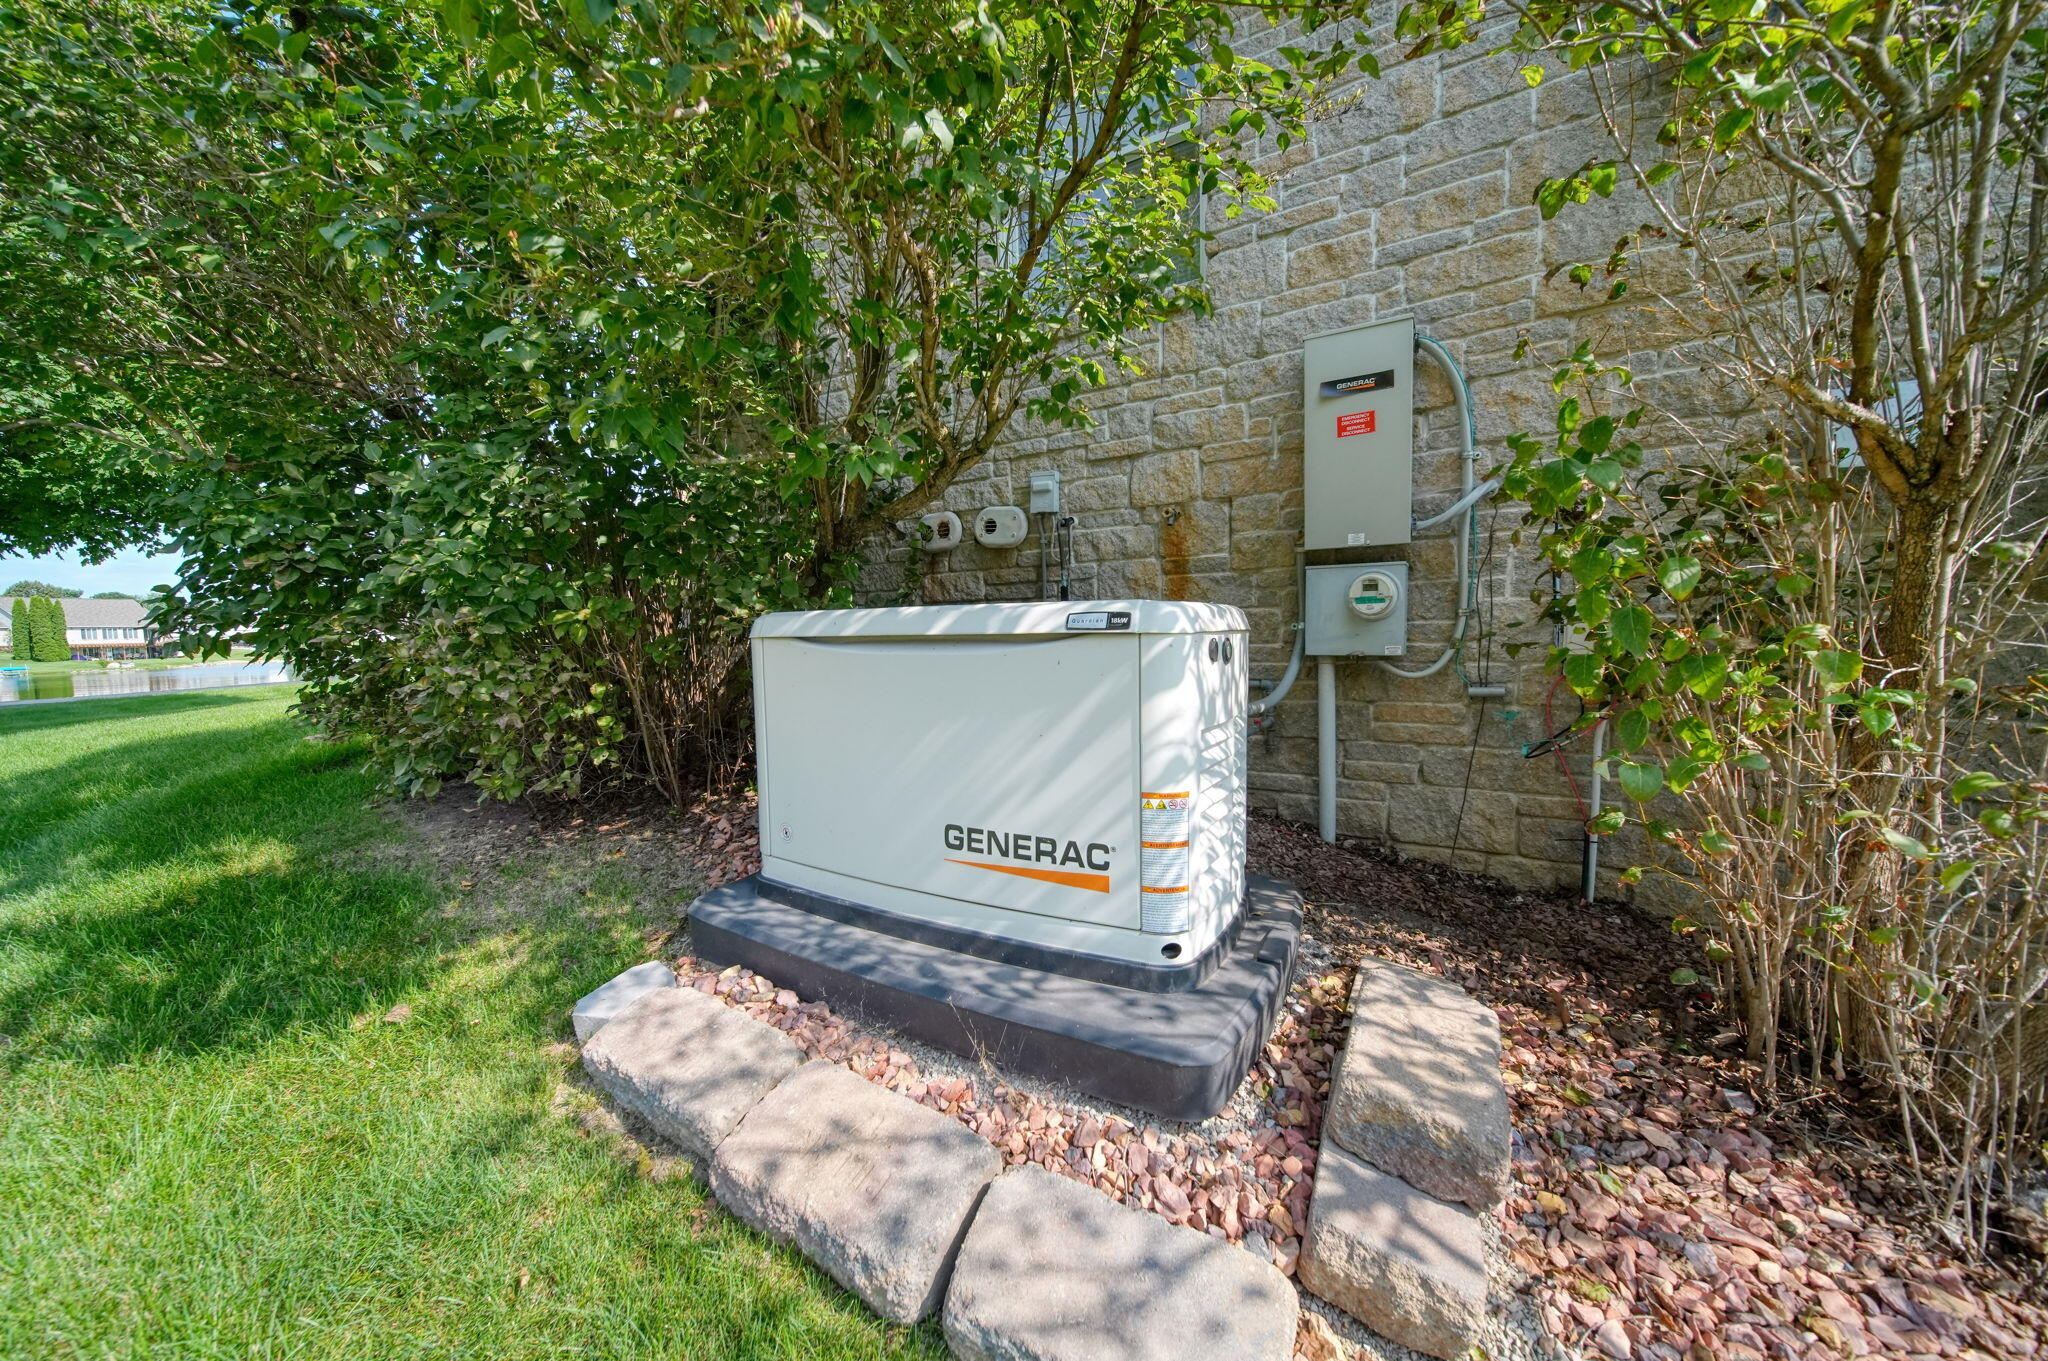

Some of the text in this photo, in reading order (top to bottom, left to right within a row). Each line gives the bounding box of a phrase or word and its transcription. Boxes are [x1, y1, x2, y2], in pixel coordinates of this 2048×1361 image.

[1336, 377, 1376, 390] GENERAC
[1341, 417, 1370, 426] DISCONNECT
[1341, 427, 1371, 436] DISCONNECT
[944, 823, 1110, 871] GENERAC
